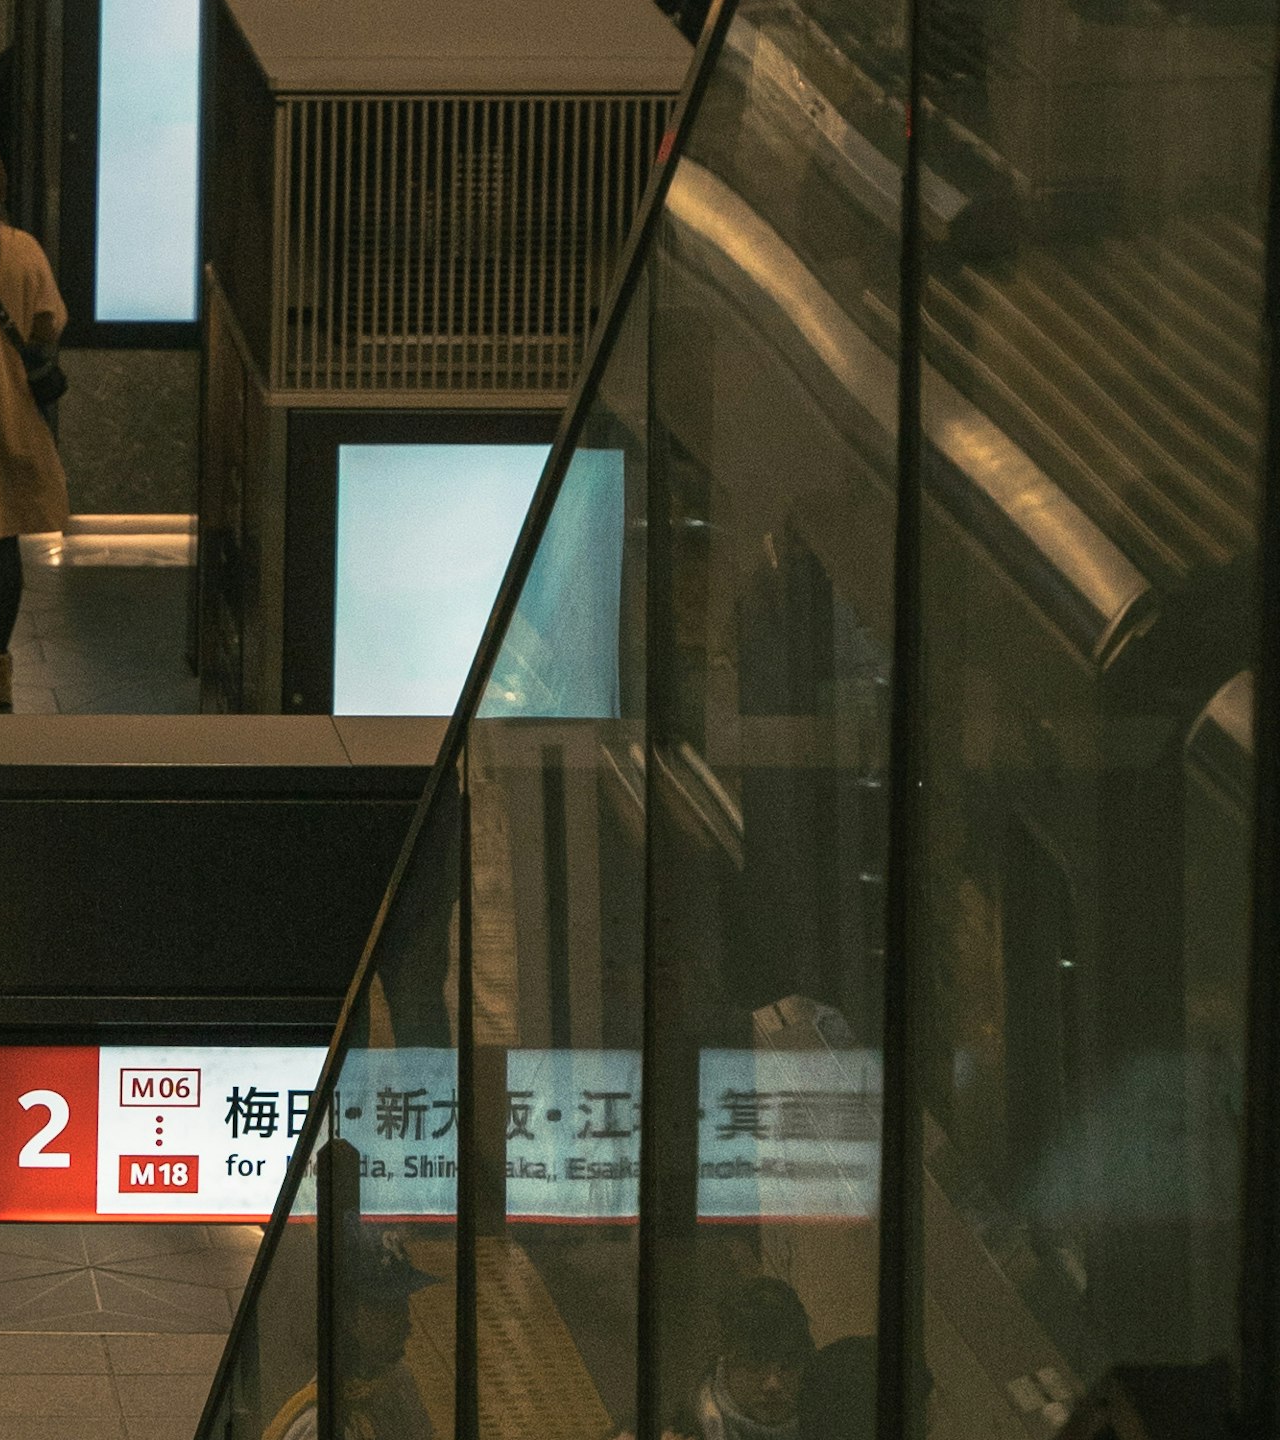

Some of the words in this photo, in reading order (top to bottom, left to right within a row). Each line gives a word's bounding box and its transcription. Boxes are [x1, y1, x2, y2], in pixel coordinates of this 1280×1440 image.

[131, 1076, 191, 1099] M06
[17, 1088, 72, 1169] 2
[130, 1162, 189, 1187] M18
[225, 1153, 266, 1177] for
